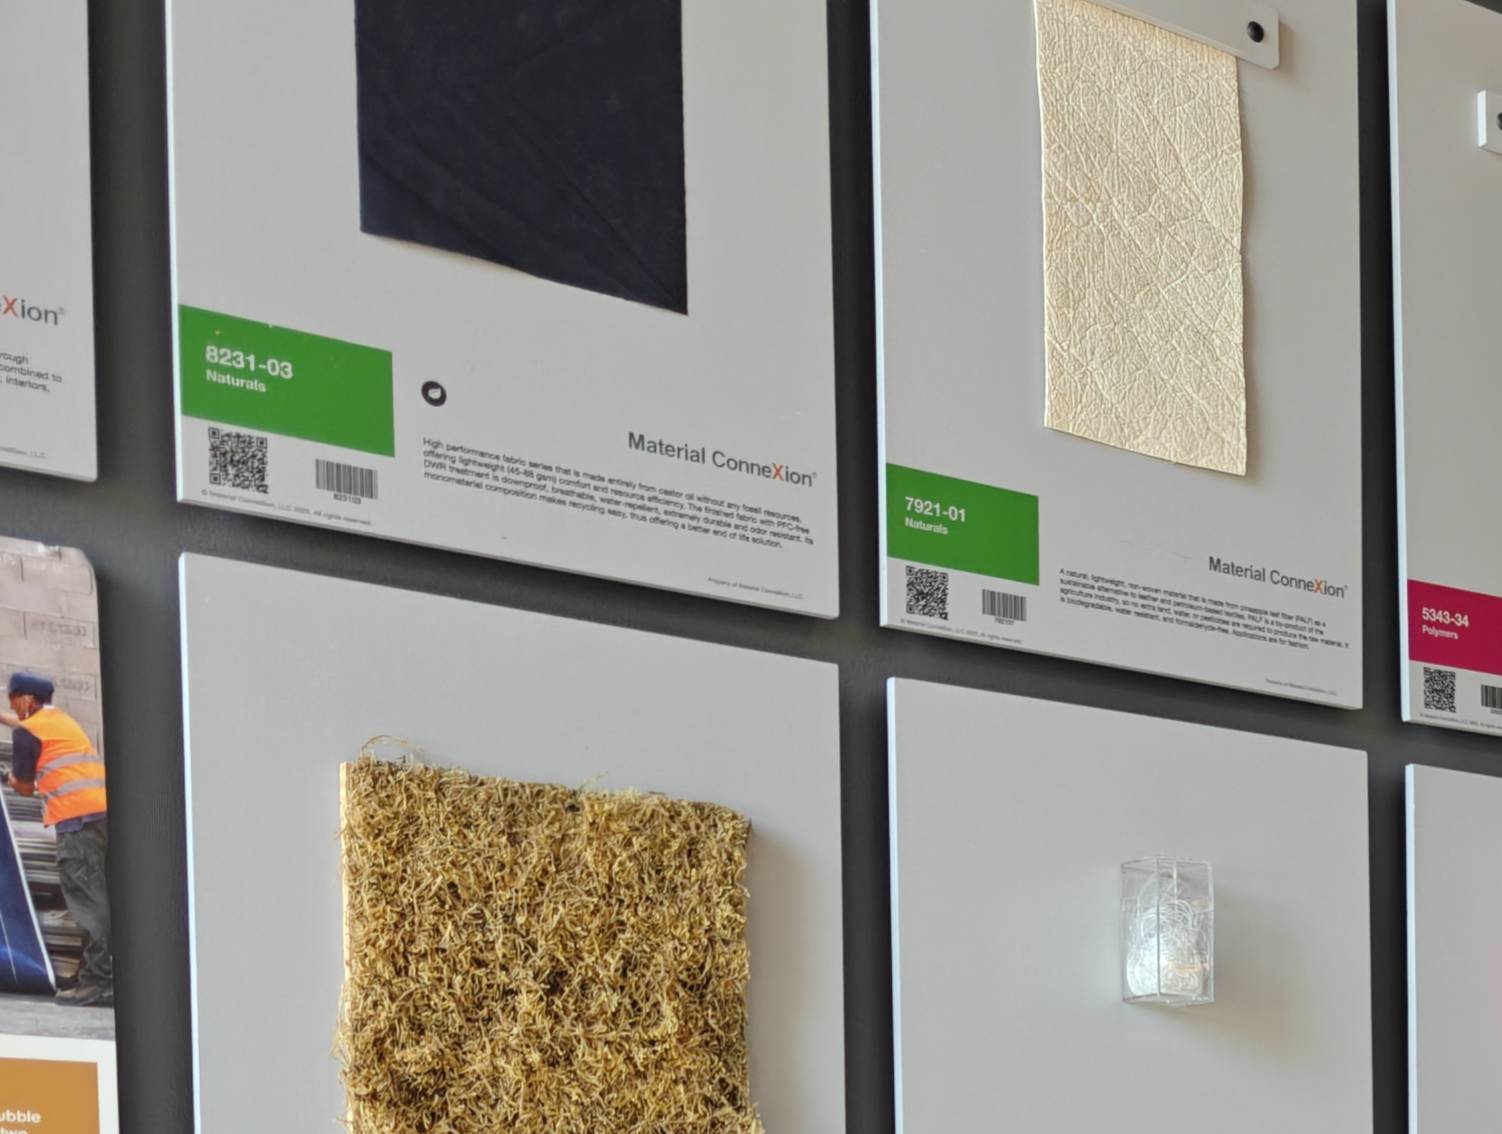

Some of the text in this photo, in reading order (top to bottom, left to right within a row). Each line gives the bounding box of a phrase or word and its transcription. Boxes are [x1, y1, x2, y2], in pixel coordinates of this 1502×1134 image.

[206, 345, 293, 379] 8231-03
[206, 369, 267, 392] Naturals
[628, 431, 705, 464] Material
[905, 495, 966, 522] 7921-01
[905, 517, 948, 535] Naturals
[1208, 556, 1265, 583] Material
[1422, 607, 1469, 628] 5343-34
